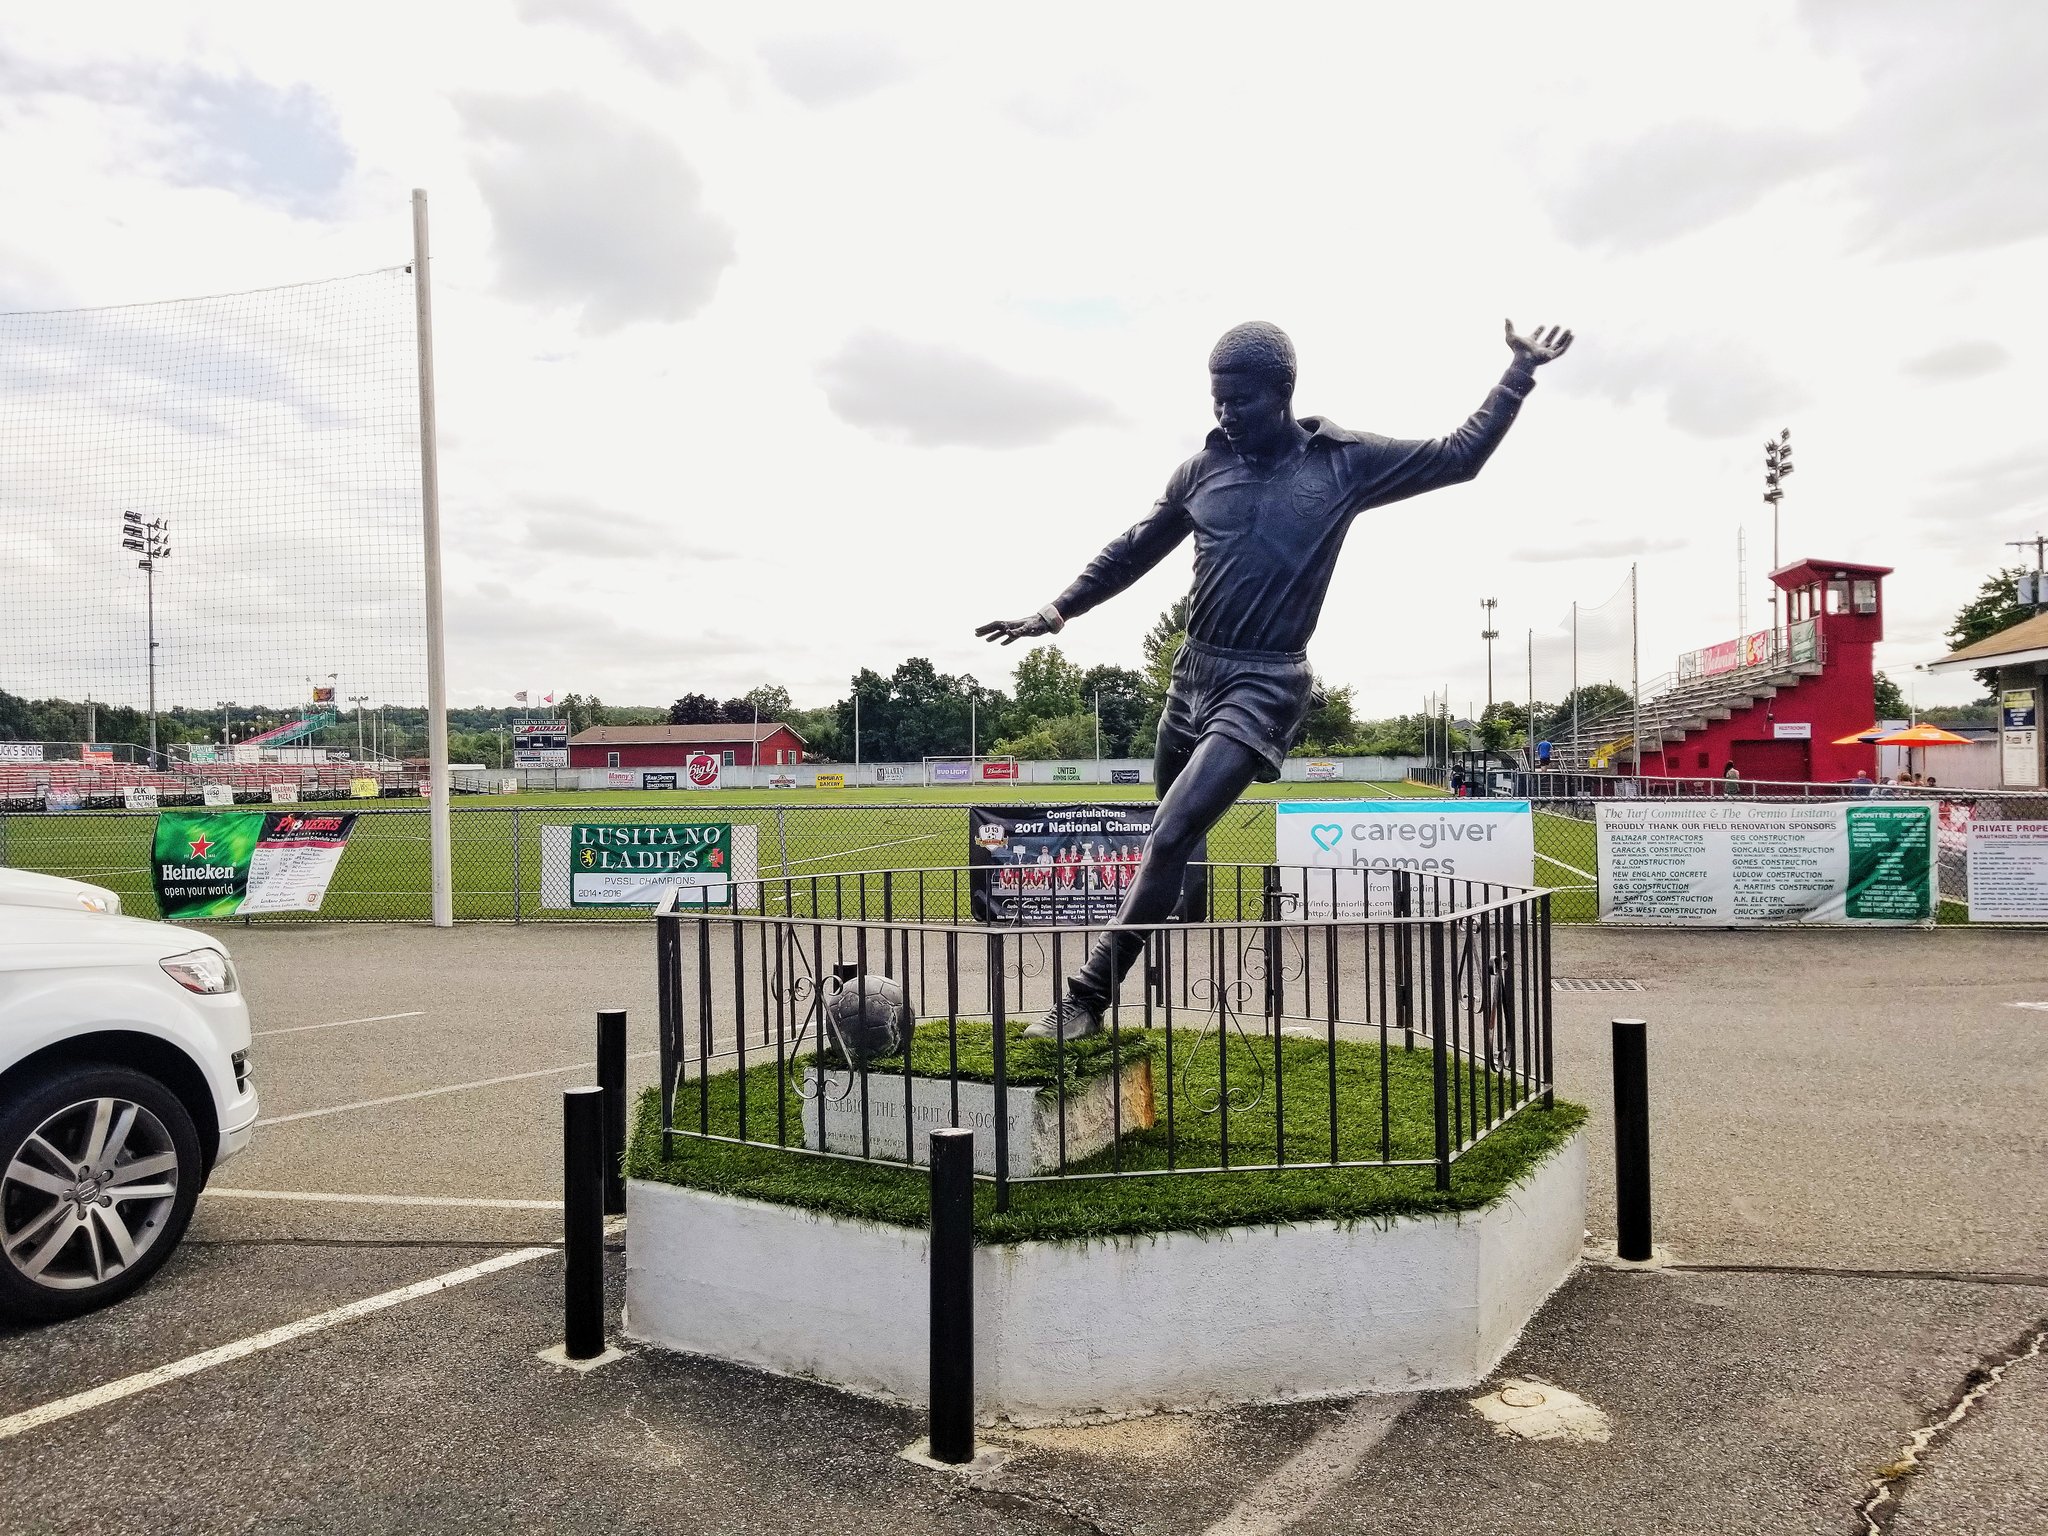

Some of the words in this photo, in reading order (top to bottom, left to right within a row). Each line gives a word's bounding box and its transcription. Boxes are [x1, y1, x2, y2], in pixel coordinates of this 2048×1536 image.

[21, 746, 42, 756] SIGNS
[609, 773, 634, 781] Manny's
[1046, 809, 1126, 819] Congratulations
[1604, 808, 1623, 818] The
[1626, 808, 1649, 821] Turf
[1651, 808, 1707, 818] Committee
[1709, 808, 1719, 818] &
[1722, 808, 1741, 818] The
[1748, 808, 1788, 818] Gremio
[1791, 808, 1837, 818] Lusitano
[1014, 823, 1044, 833] 2017
[1048, 821, 1102, 833] National
[1350, 817, 1498, 849] caregiver
[580, 827, 721, 845] LUSITANO
[600, 850, 699, 869] LADIES
[162, 864, 235, 880] Heineken
[604, 877, 633, 885] PVSSL
[639, 877, 696, 885] CHAMPIONS
[164, 887, 185, 898] open
[187, 887, 206, 898] your
[208, 883, 234, 895] world
[578, 889, 597, 898] 2014
[603, 889, 622, 898] 2016
[1369, 884, 1390, 892] from
